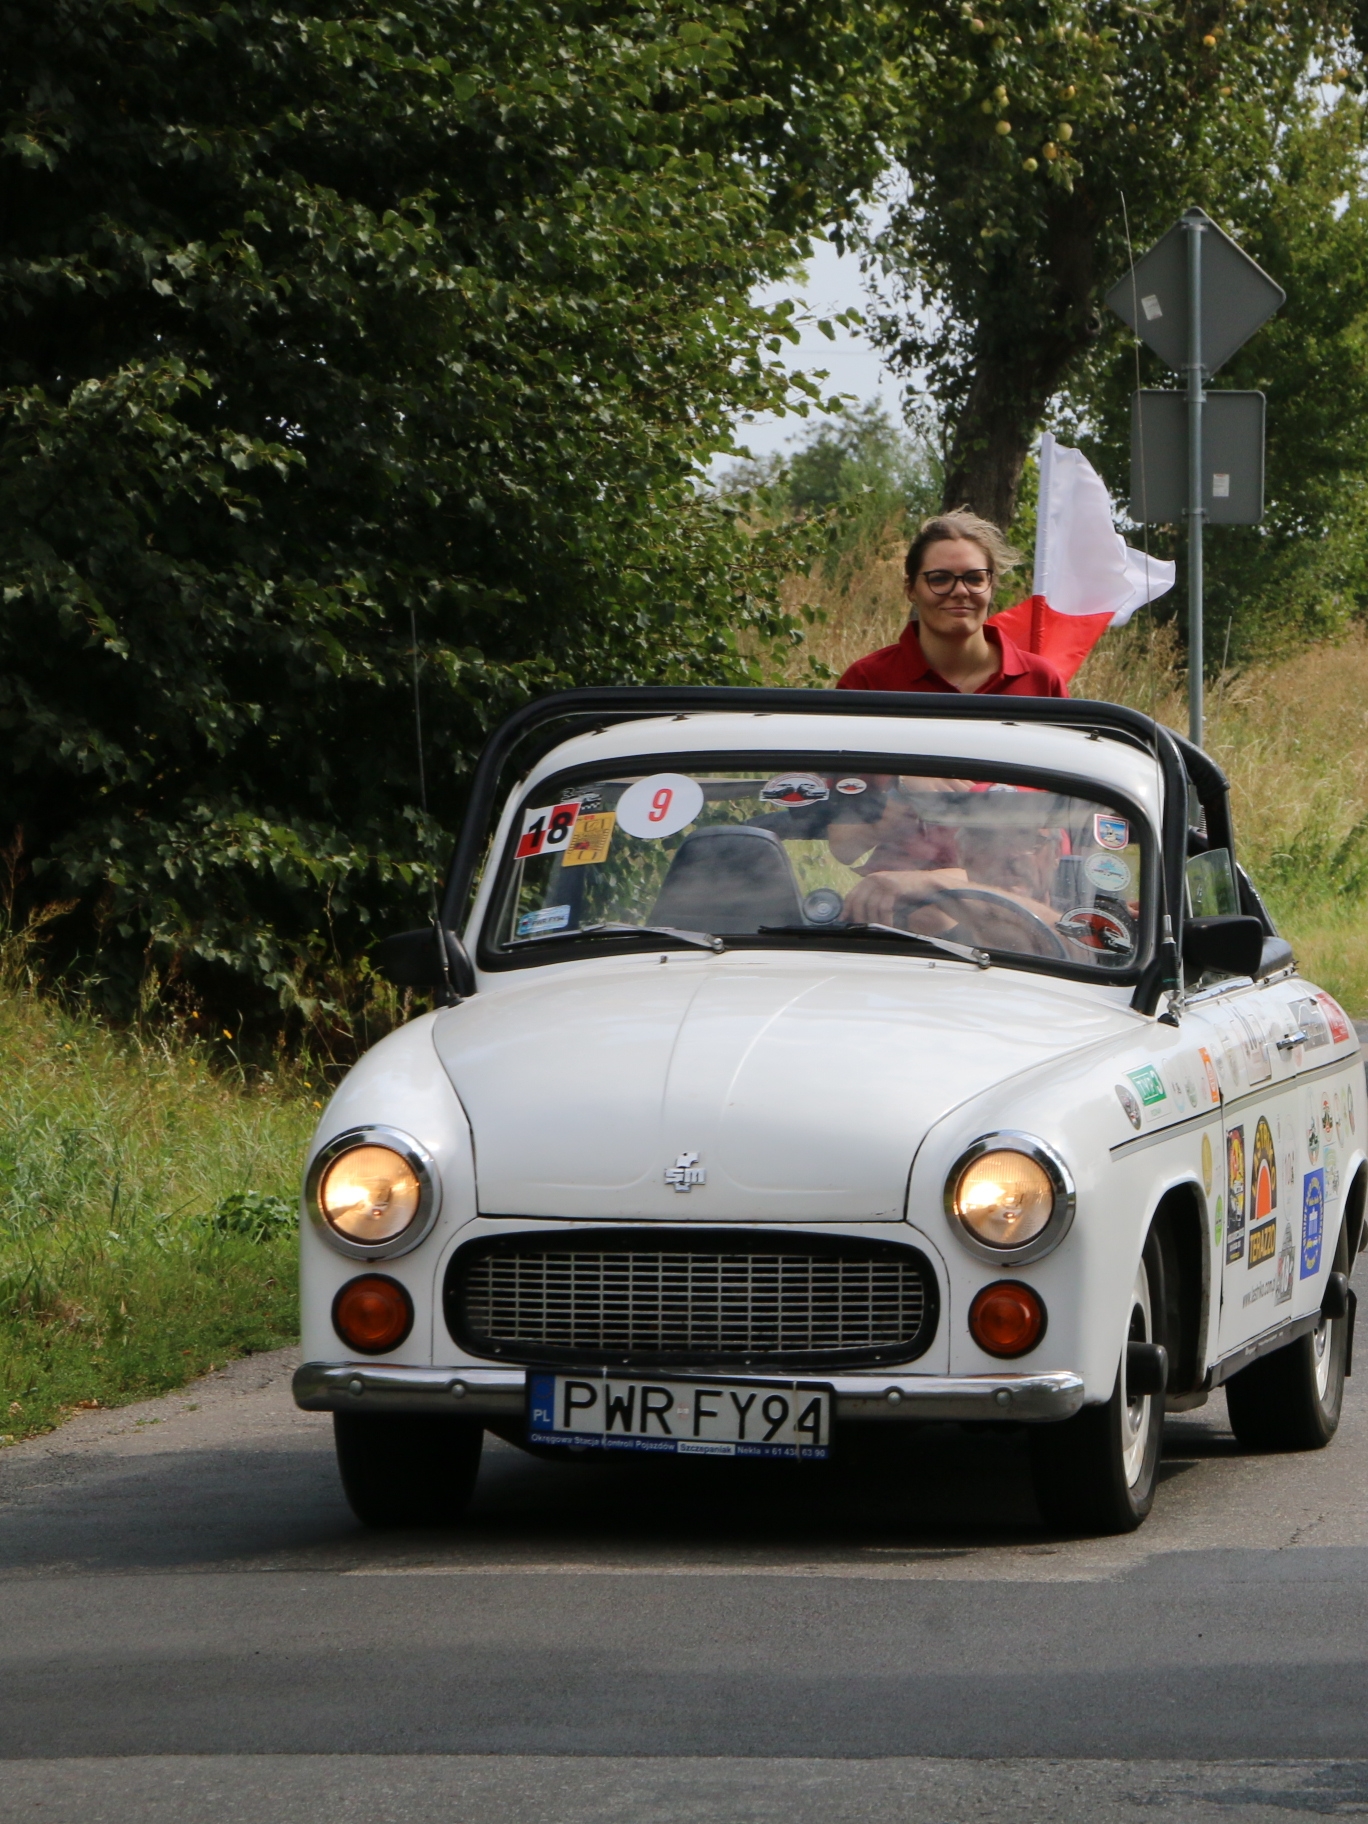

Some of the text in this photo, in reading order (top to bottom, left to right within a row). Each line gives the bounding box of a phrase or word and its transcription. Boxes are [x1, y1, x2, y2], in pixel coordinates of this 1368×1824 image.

[648, 788, 673, 822] 9
[529, 811, 573, 848] 18
[1250, 1223, 1275, 1263] TERAZZO
[533, 1408, 551, 1422] PL
[563, 1380, 822, 1445] PWR FY94
